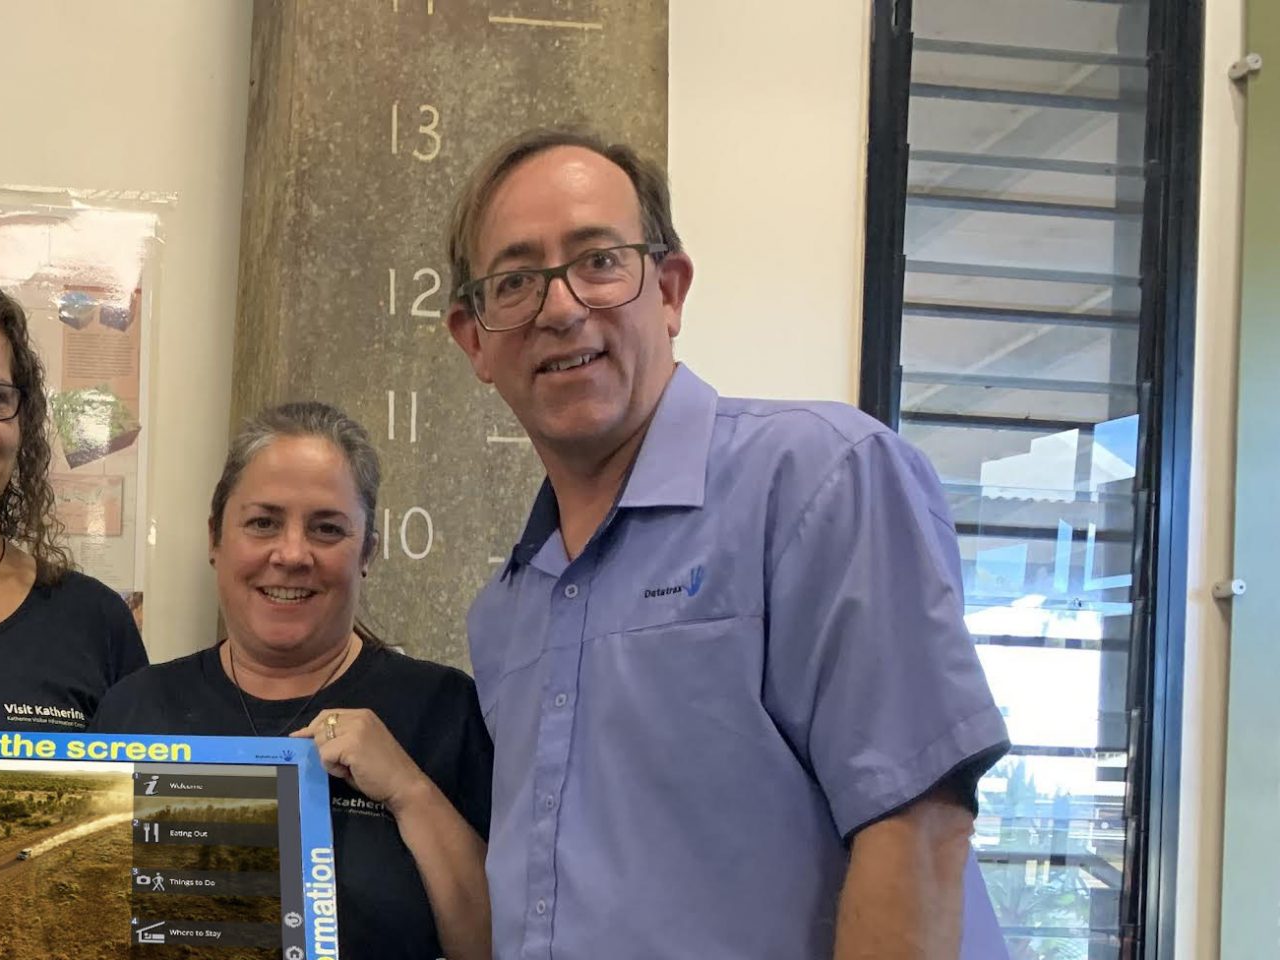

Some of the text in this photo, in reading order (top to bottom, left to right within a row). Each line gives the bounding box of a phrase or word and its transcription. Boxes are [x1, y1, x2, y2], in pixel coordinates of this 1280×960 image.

[390, 101, 442, 163] 13
[388, 268, 442, 318] 12
[387, 390, 417, 442] 11
[383, 508, 434, 560] 10
[4, 703, 33, 714] Visit
[0, 733, 56, 758] the
[67, 740, 192, 762] screen
[170, 830, 192, 838] Eating
[170, 929, 194, 937] Where
[205, 929, 222, 939] Stay
